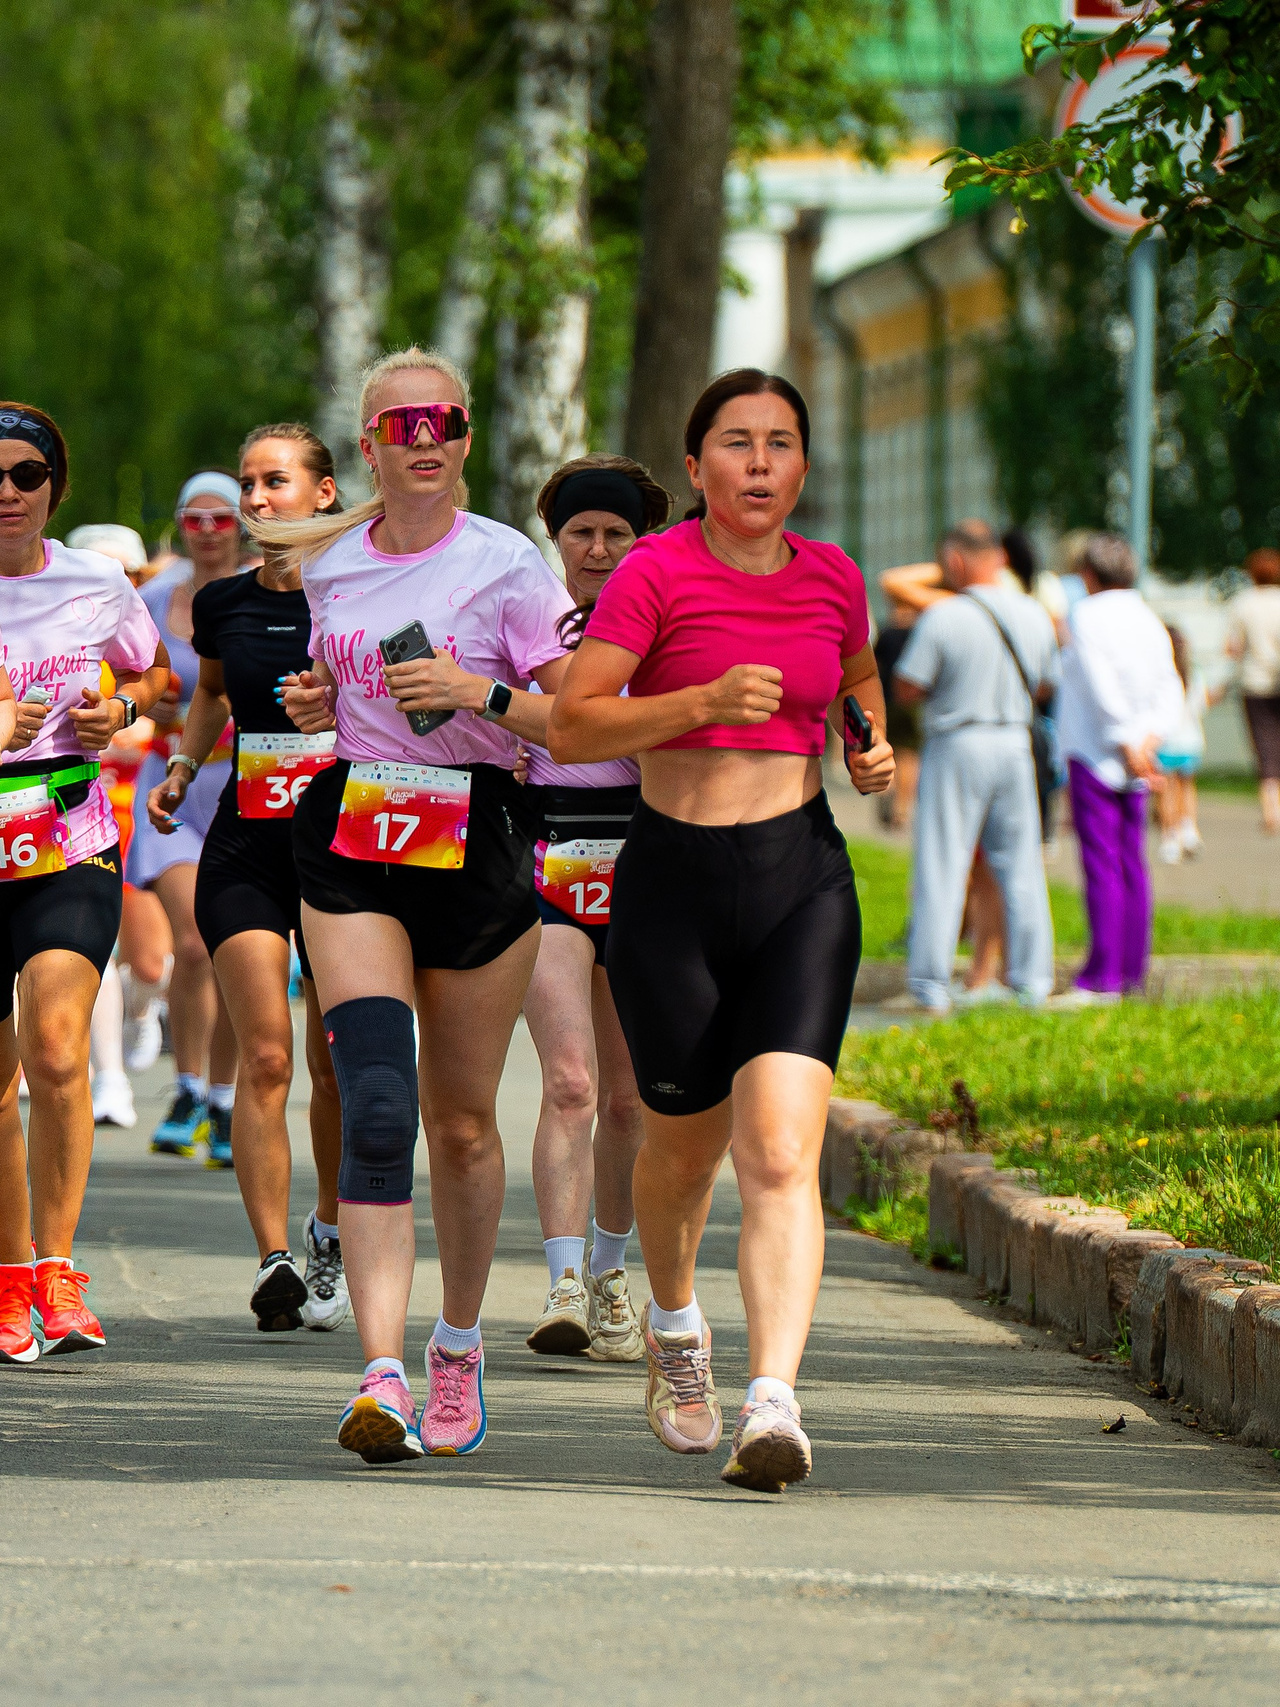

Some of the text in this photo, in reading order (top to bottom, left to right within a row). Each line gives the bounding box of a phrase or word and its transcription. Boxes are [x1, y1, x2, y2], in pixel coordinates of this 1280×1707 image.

[3, 644, 89, 690] енский
[373, 812, 420, 852] 17
[568, 881, 611, 915] 12
